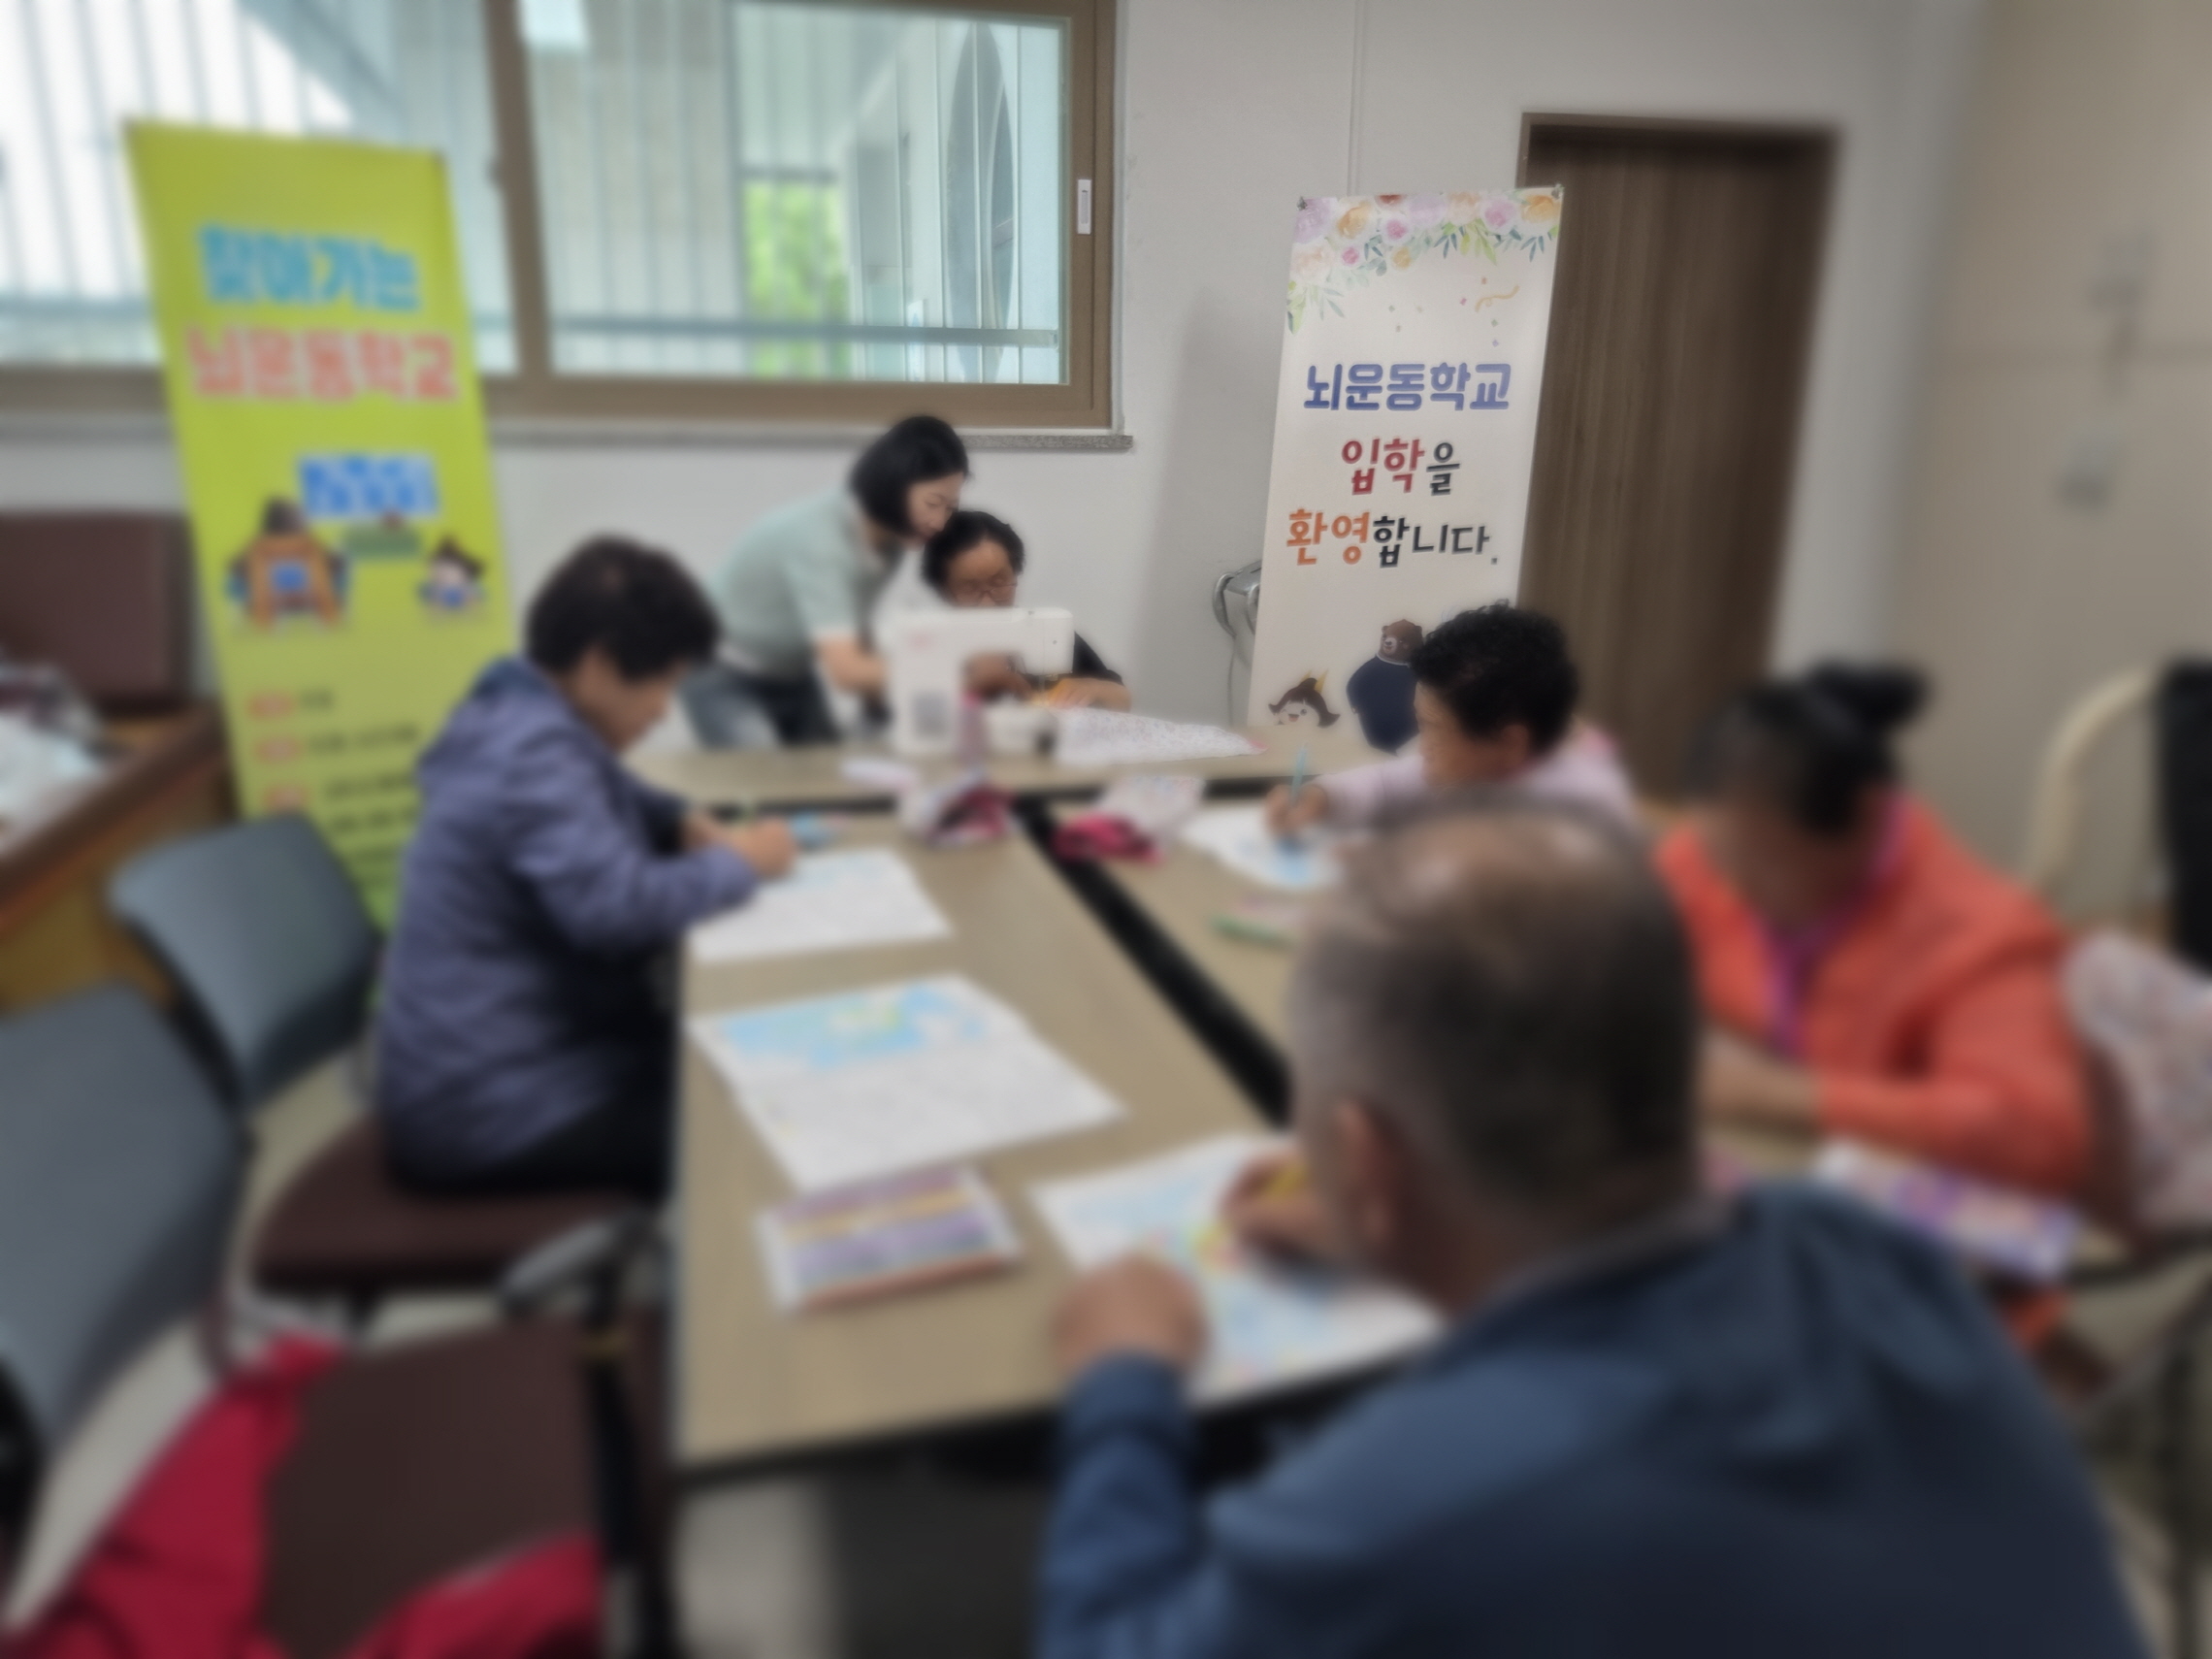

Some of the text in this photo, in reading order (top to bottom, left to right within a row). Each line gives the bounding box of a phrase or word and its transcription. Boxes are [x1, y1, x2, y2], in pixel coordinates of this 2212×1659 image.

[185, 326, 460, 402] 뇌운동학교
[1304, 363, 1512, 411] 뇌운동학교
[1342, 439, 1460, 496] 입학을
[1286, 508, 1498, 568] 환영합니다.
